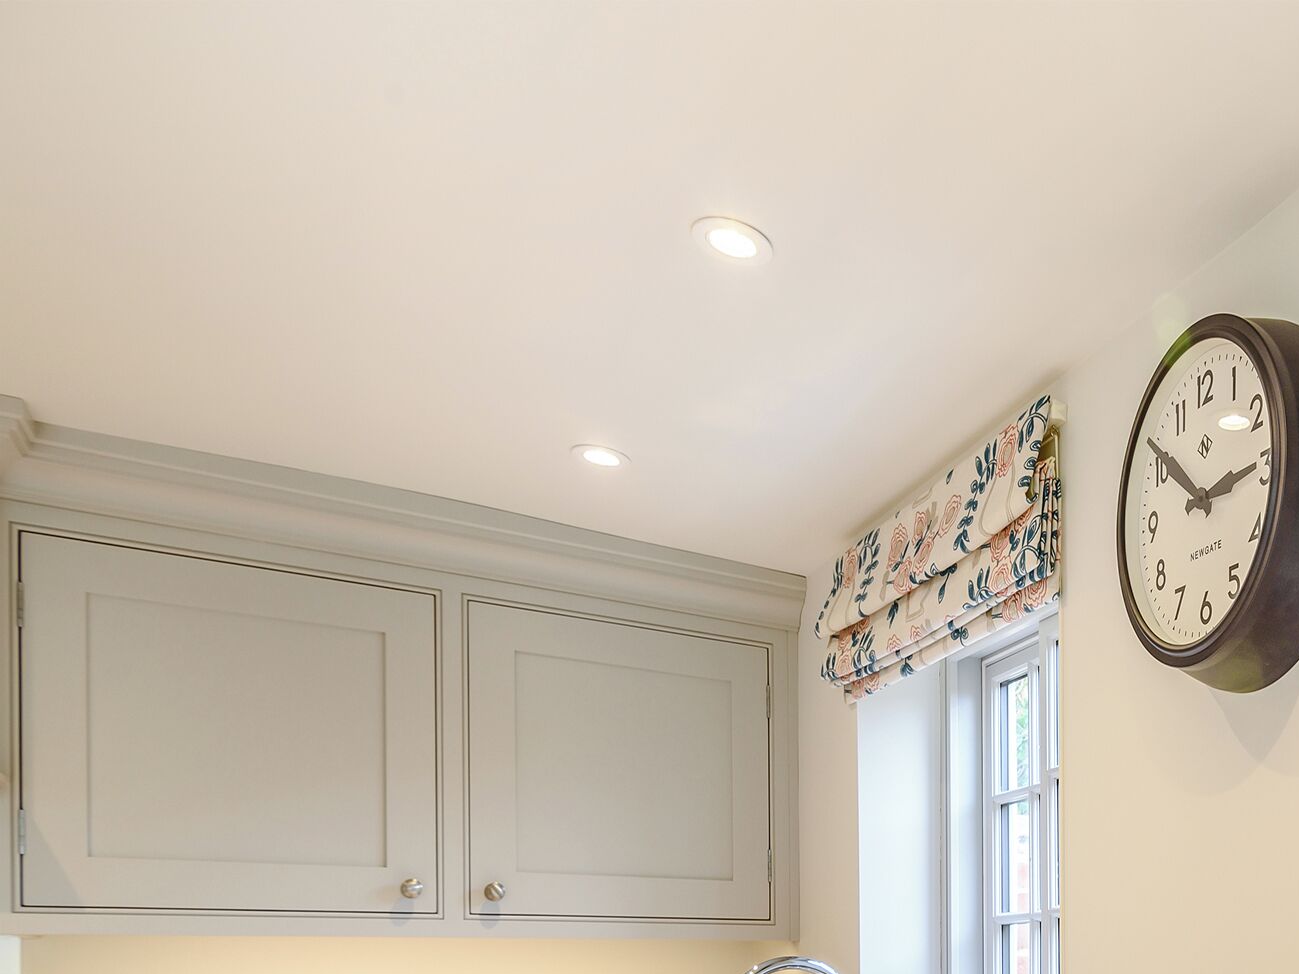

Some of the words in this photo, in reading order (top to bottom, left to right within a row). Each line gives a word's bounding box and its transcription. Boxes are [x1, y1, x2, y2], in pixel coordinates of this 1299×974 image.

[1197, 369, 1214, 409] 12
[1231, 366, 1237, 401] 1
[1175, 399, 1186, 437] 11
[1249, 393, 1264, 433] 2
[1155, 451, 1169, 488] 10
[1259, 447, 1271, 486] 3
[1148, 510, 1159, 544] 9
[1247, 511, 1261, 543] 4
[1190, 539, 1222, 562] NEWGATE
[1155, 558, 1166, 591] 8
[1227, 562, 1241, 600] 5
[1174, 584, 1187, 621] 7
[1200, 590, 1213, 625] 6
